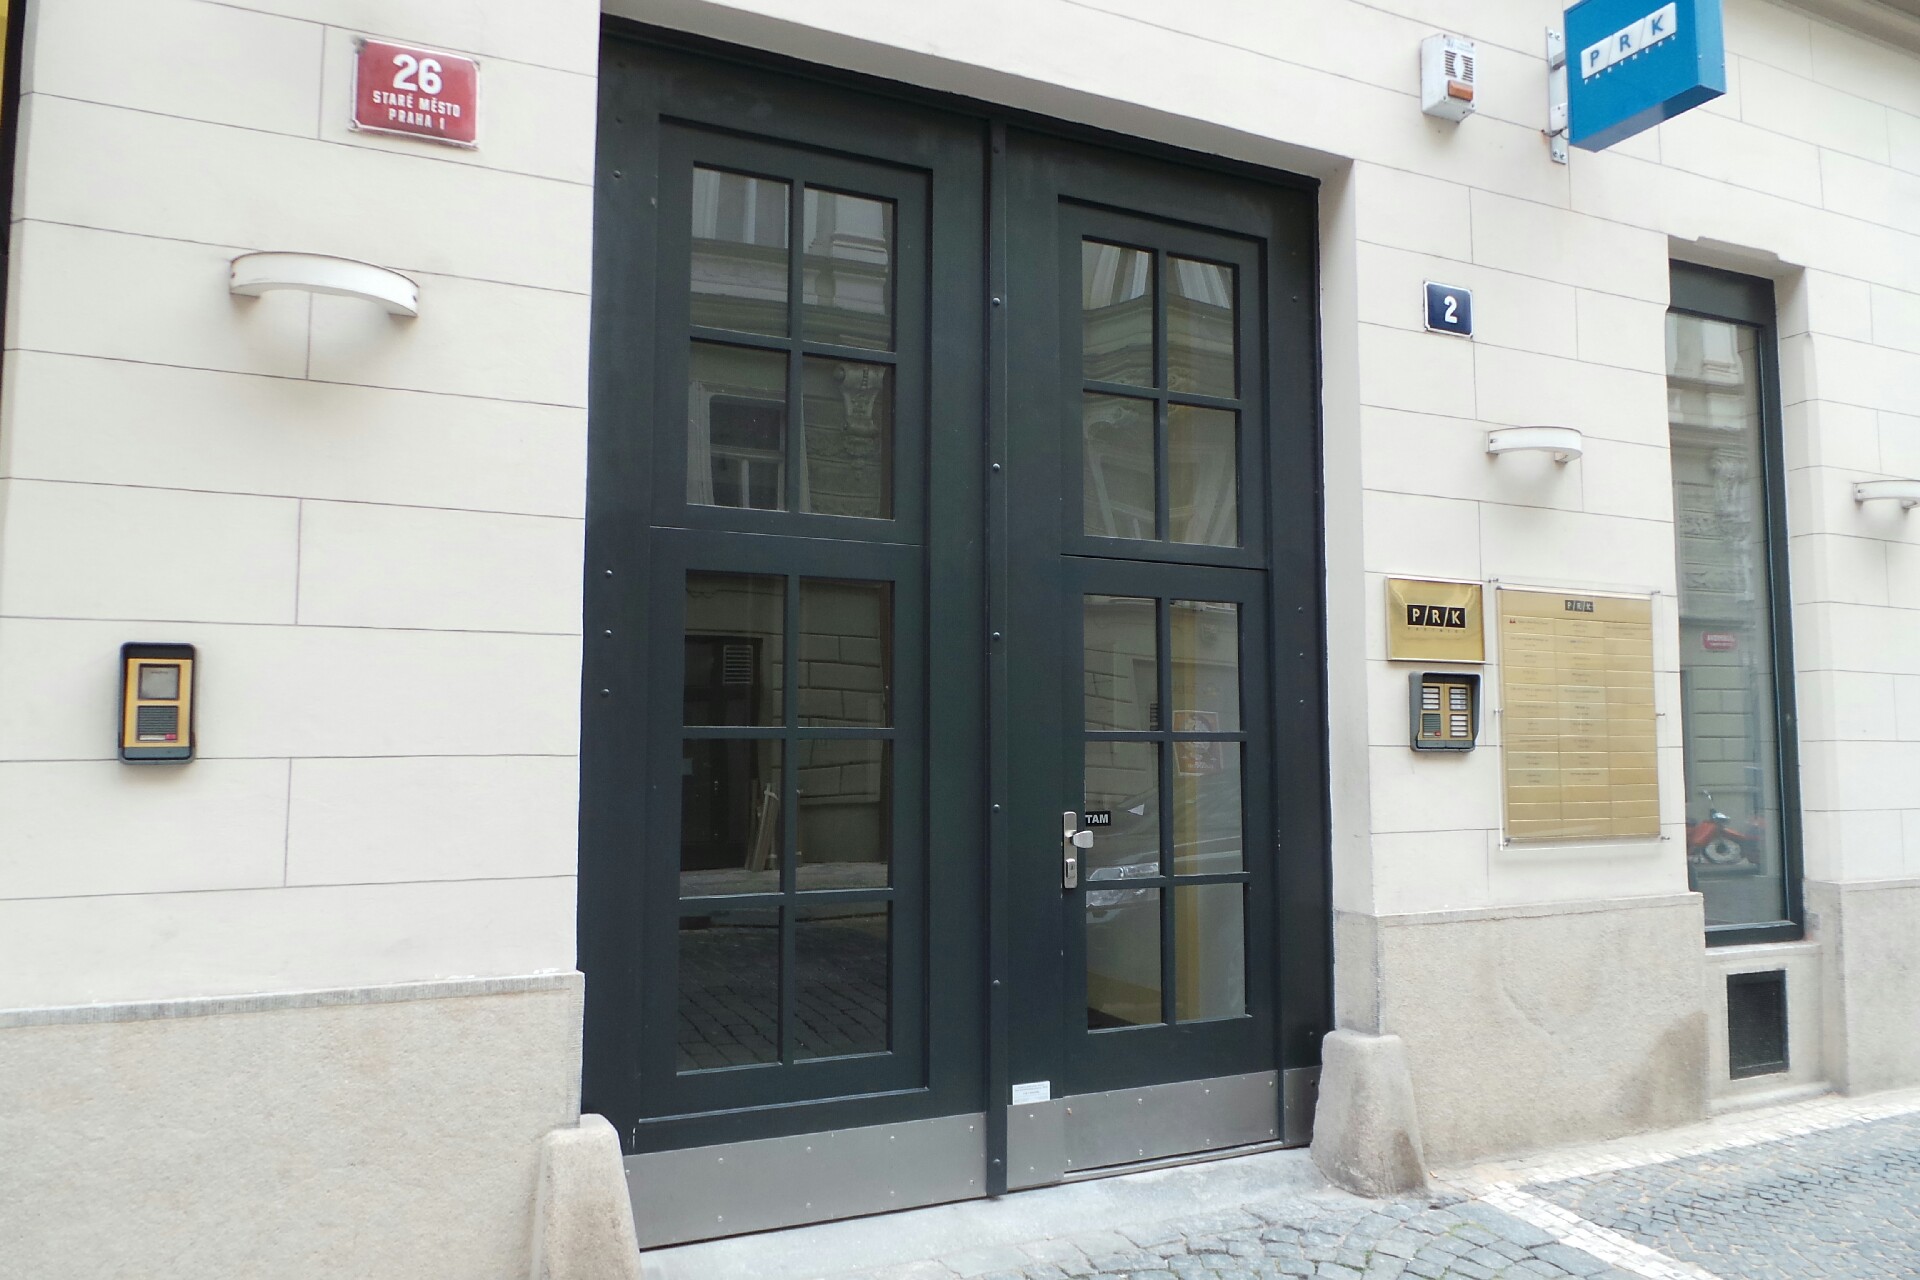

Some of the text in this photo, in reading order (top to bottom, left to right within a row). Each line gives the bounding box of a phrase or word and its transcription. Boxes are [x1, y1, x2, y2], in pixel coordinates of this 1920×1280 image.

[393, 54, 443, 95] 26
[372, 90, 413, 108] STARÉ
[388, 108, 432, 128] PRAHA
[1444, 295, 1458, 324] 2
[1085, 813, 1109, 824] TAM
